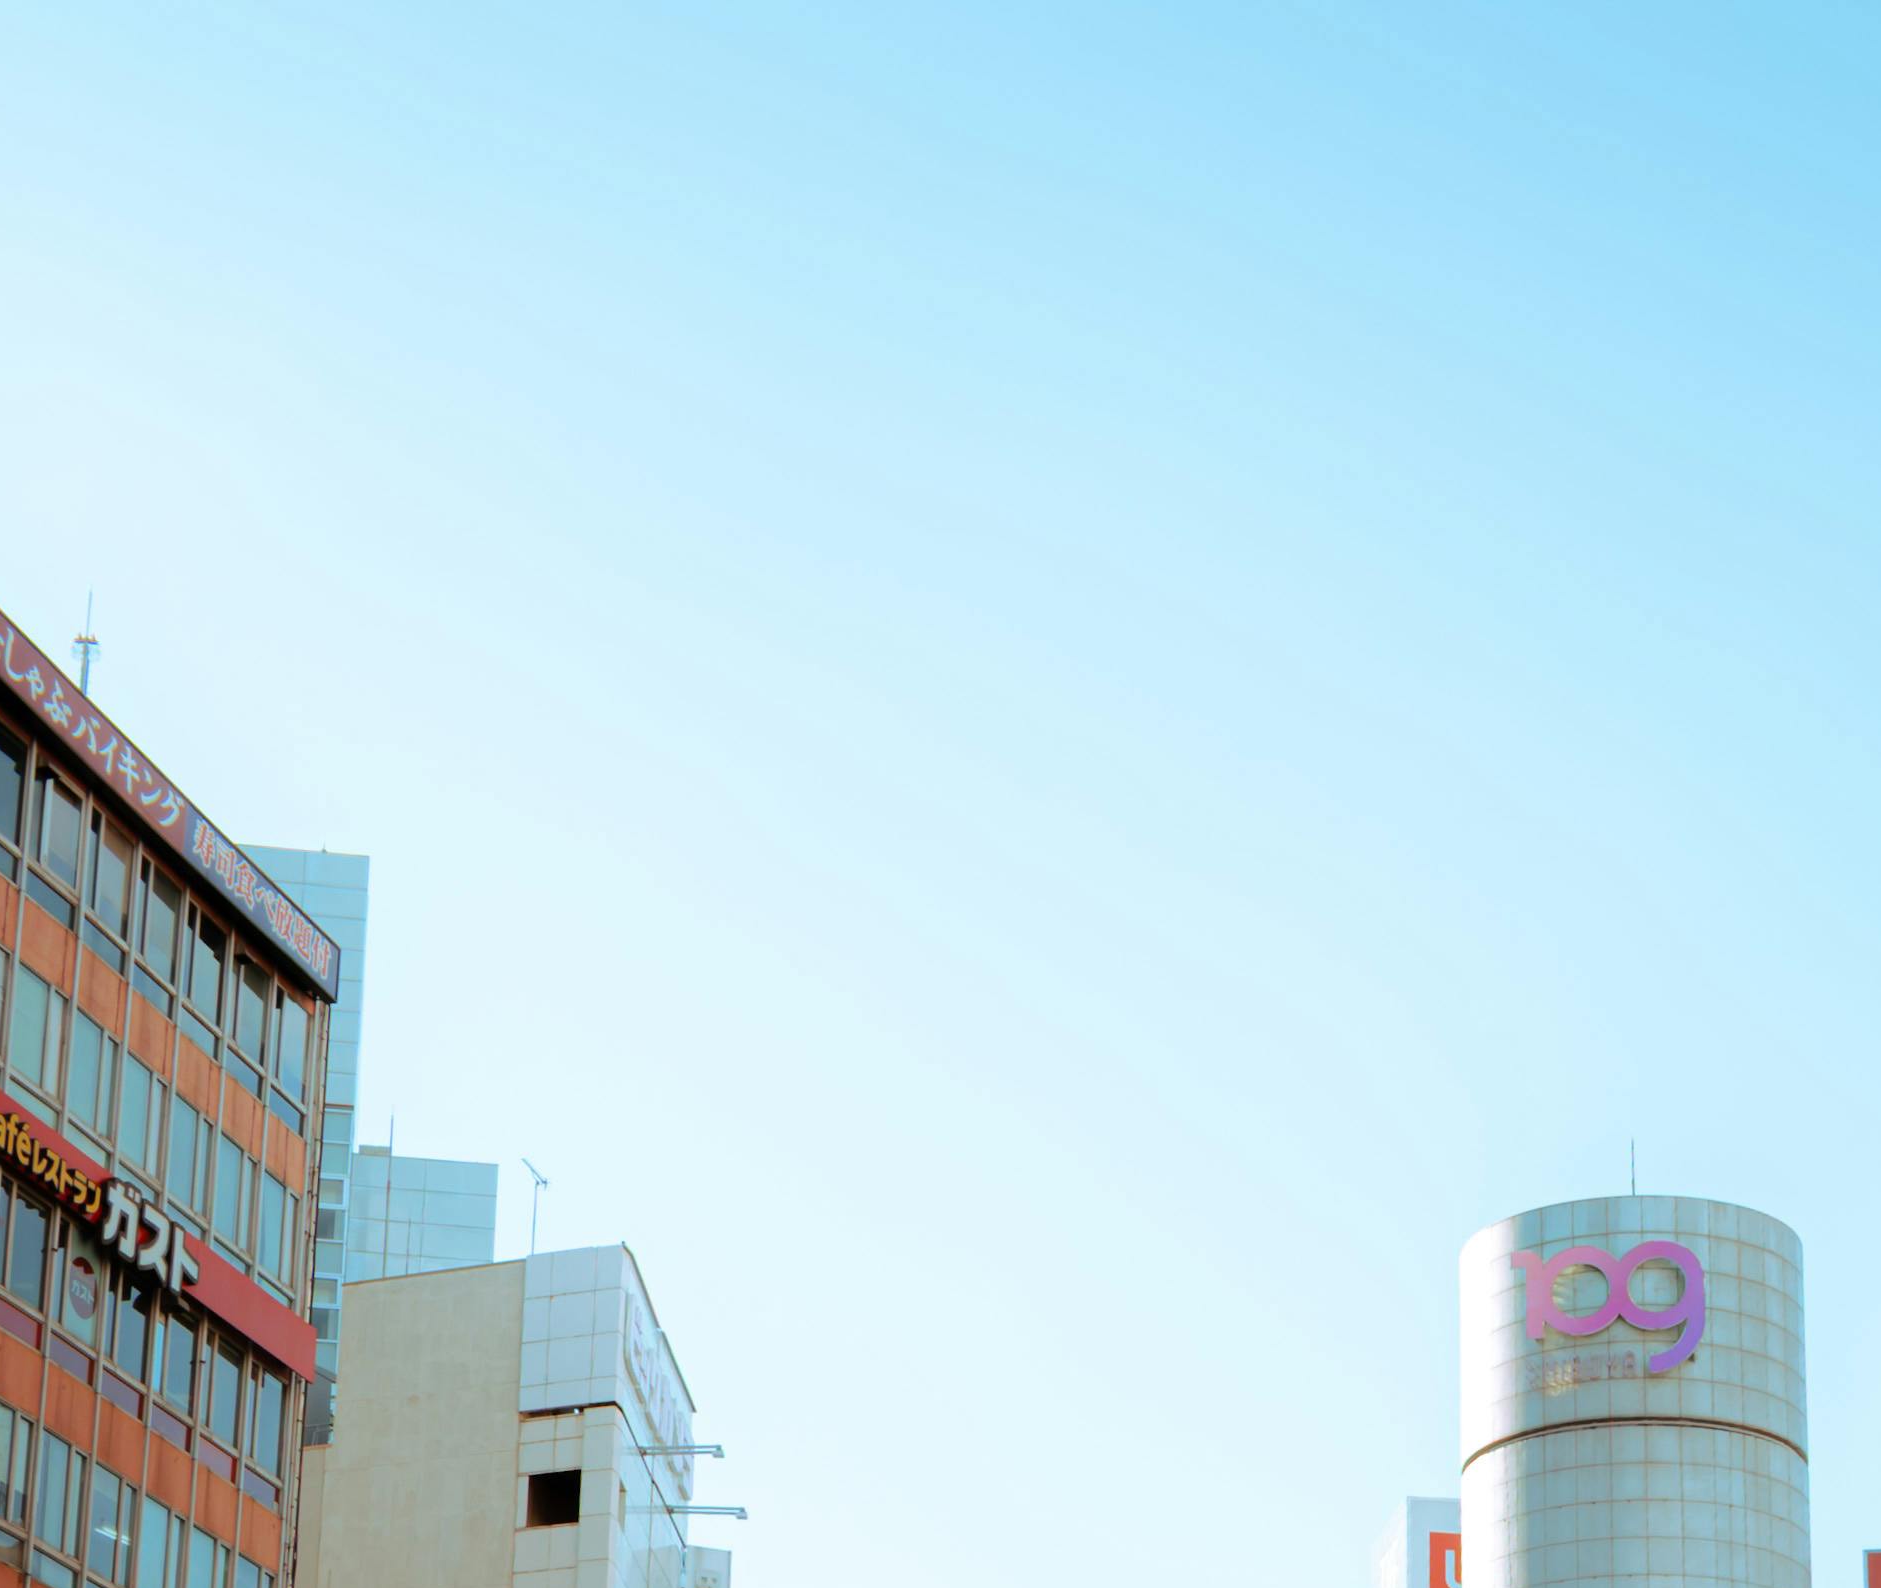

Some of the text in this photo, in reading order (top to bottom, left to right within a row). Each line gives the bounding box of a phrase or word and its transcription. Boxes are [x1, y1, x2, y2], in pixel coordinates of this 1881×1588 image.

[102, 1178, 200, 1293] ガスト
[1510, 1240, 1706, 1374] 109
